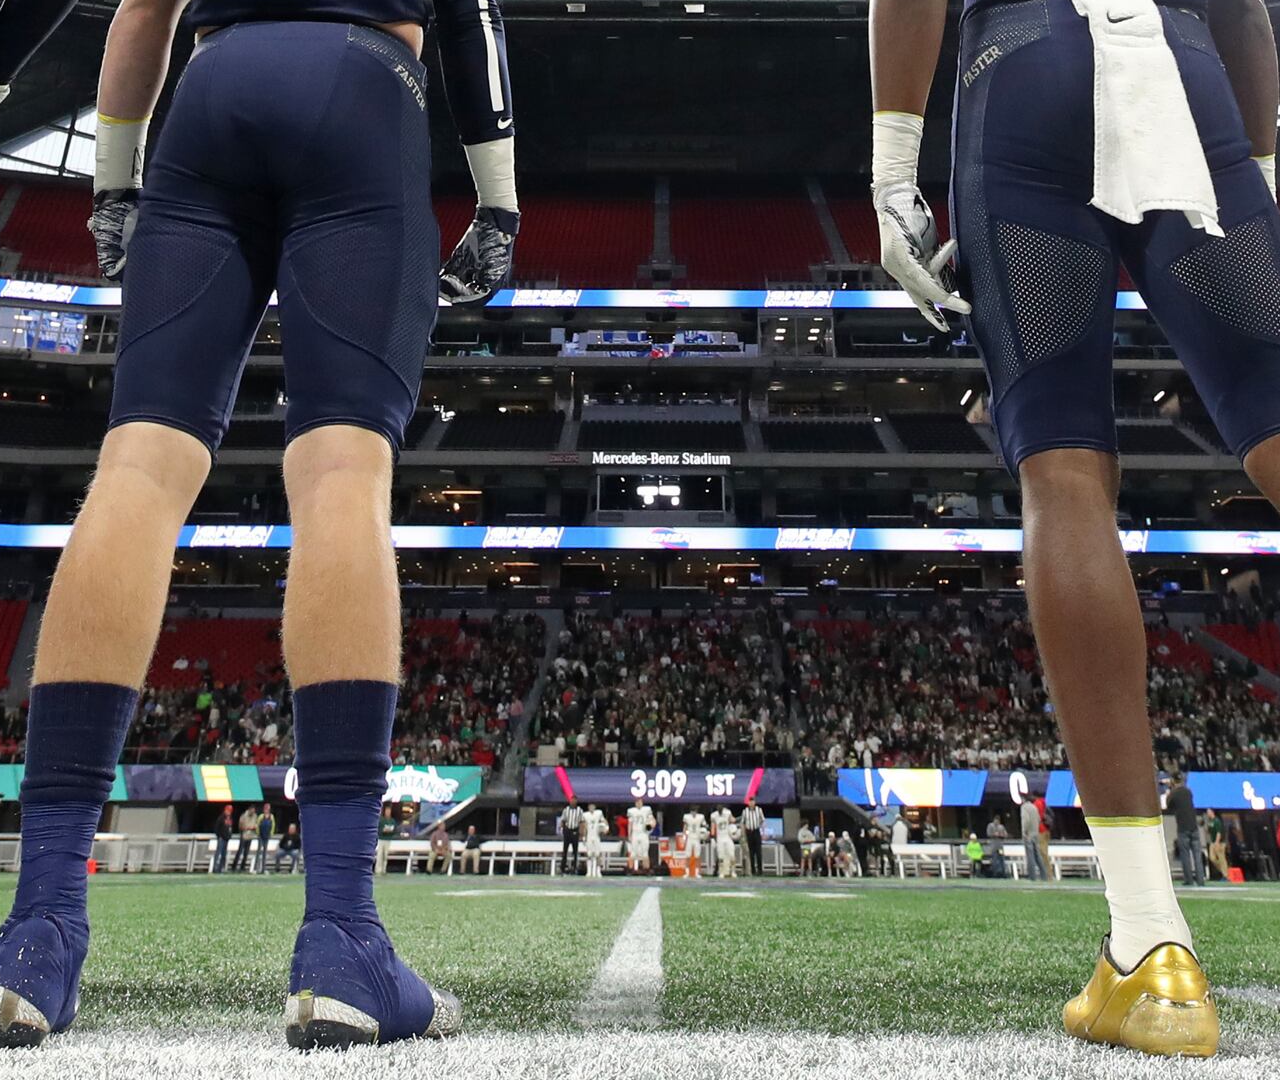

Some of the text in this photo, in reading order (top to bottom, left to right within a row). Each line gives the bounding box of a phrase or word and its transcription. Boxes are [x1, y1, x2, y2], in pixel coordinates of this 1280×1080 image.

[962, 45, 1003, 88] FASTER
[394, 64, 426, 111] FASTER
[592, 451, 680, 465] Mercedes-Benz
[682, 452, 731, 465] Stadium
[630, 769, 687, 798] 3:09
[705, 773, 735, 796] 1ST
